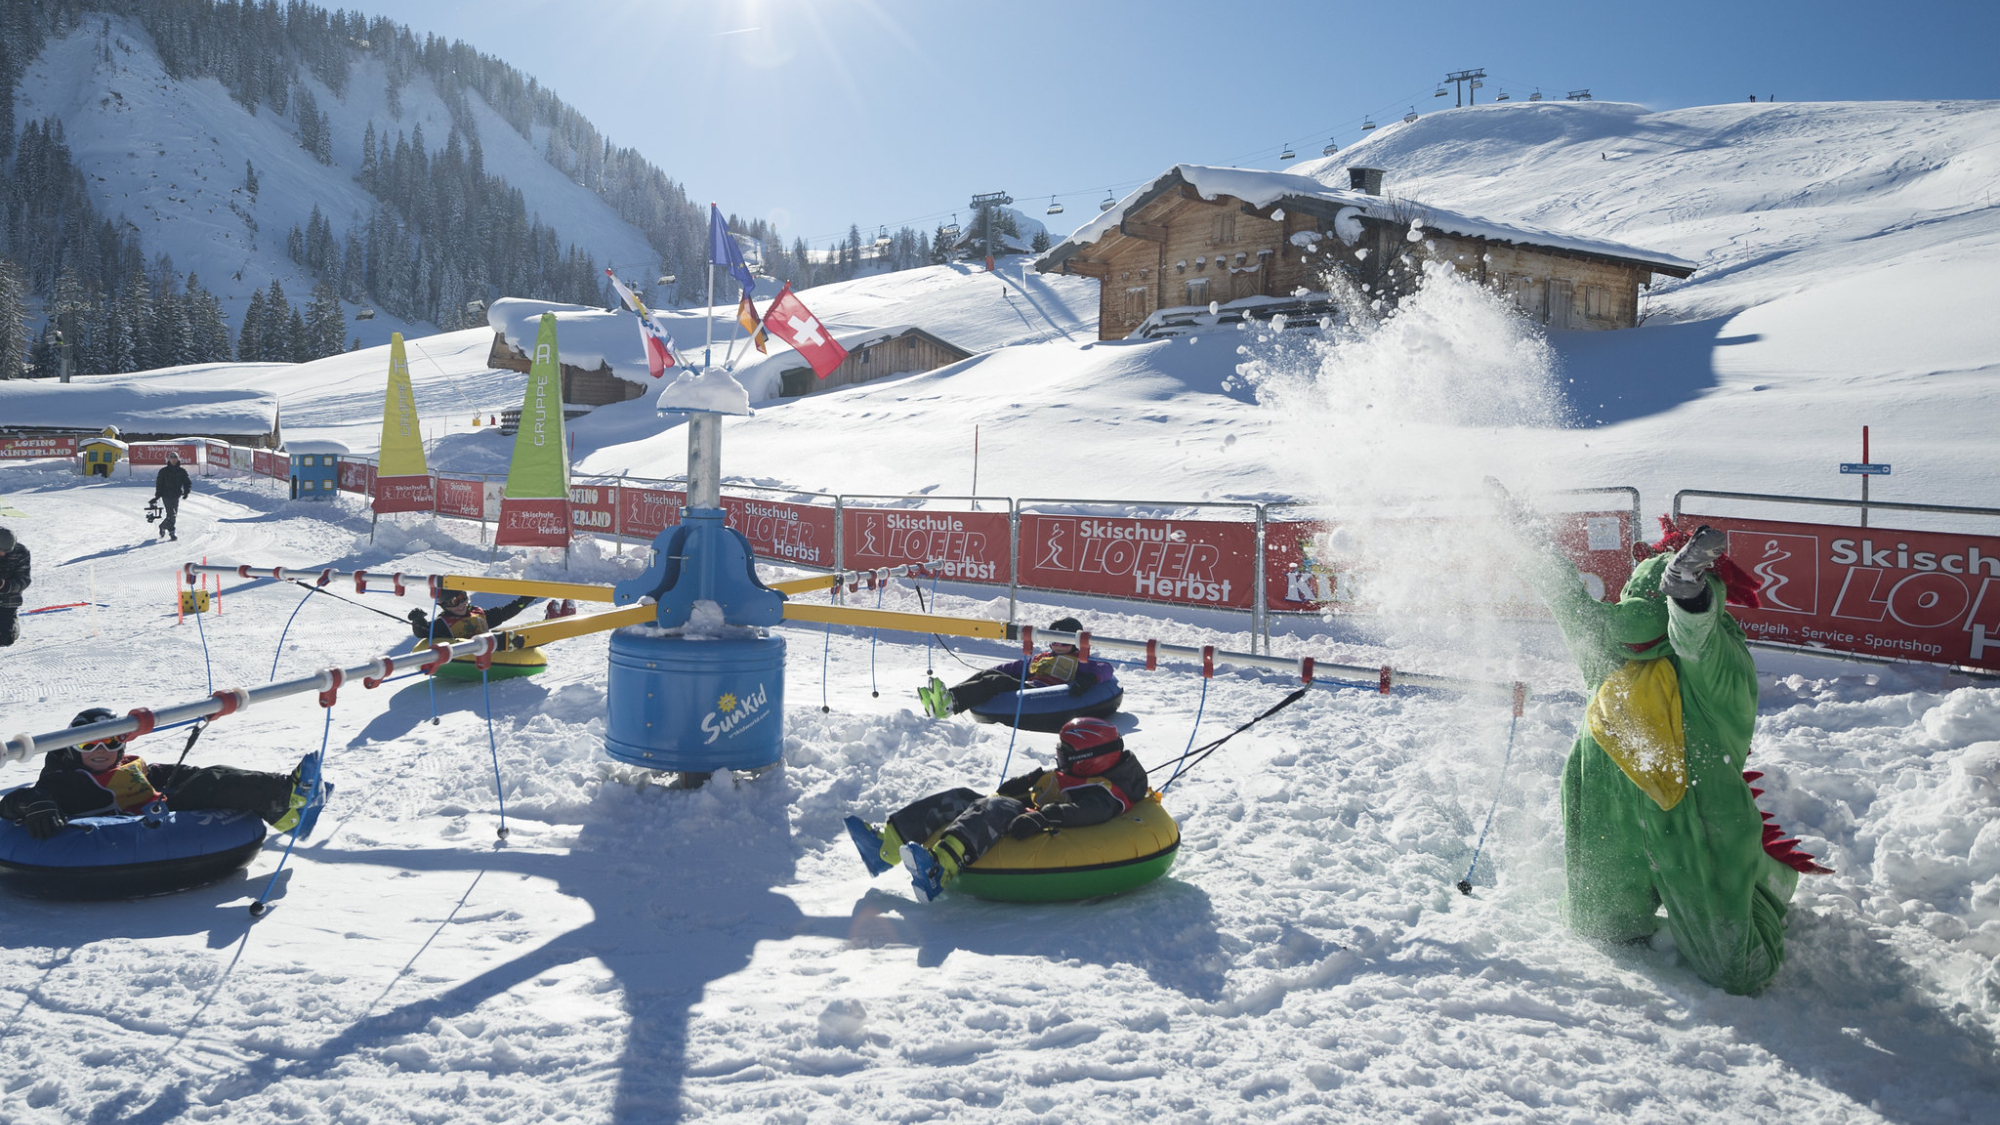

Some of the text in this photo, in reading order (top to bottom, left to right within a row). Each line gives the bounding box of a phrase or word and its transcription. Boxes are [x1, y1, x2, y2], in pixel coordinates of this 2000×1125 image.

[398, 382, 410, 436] GRUPPE
[534, 375, 548, 447] GRUPPE
[0, 448, 72, 457] KINDERLAND
[14, 439, 57, 448] LOFINO
[570, 488, 599, 505] OFINO
[643, 492, 683, 507] Skischule
[521, 510, 554, 519] Skischule
[745, 502, 799, 521] Skischule
[886, 513, 964, 532] Skischule
[538, 525, 566, 535] Herbst
[745, 514, 815, 549] LOFER
[1079, 520, 1187, 543] Skischule
[773, 539, 820, 562] Herbst
[887, 528, 987, 564] LOFER
[1078, 537, 1220, 583] LOFER
[1134, 569, 1232, 602] Herbst
[1737, 618, 1789, 636] iverleih
[1801, 626, 1854, 644] Service
[1864, 633, 1942, 657] Sportshop
